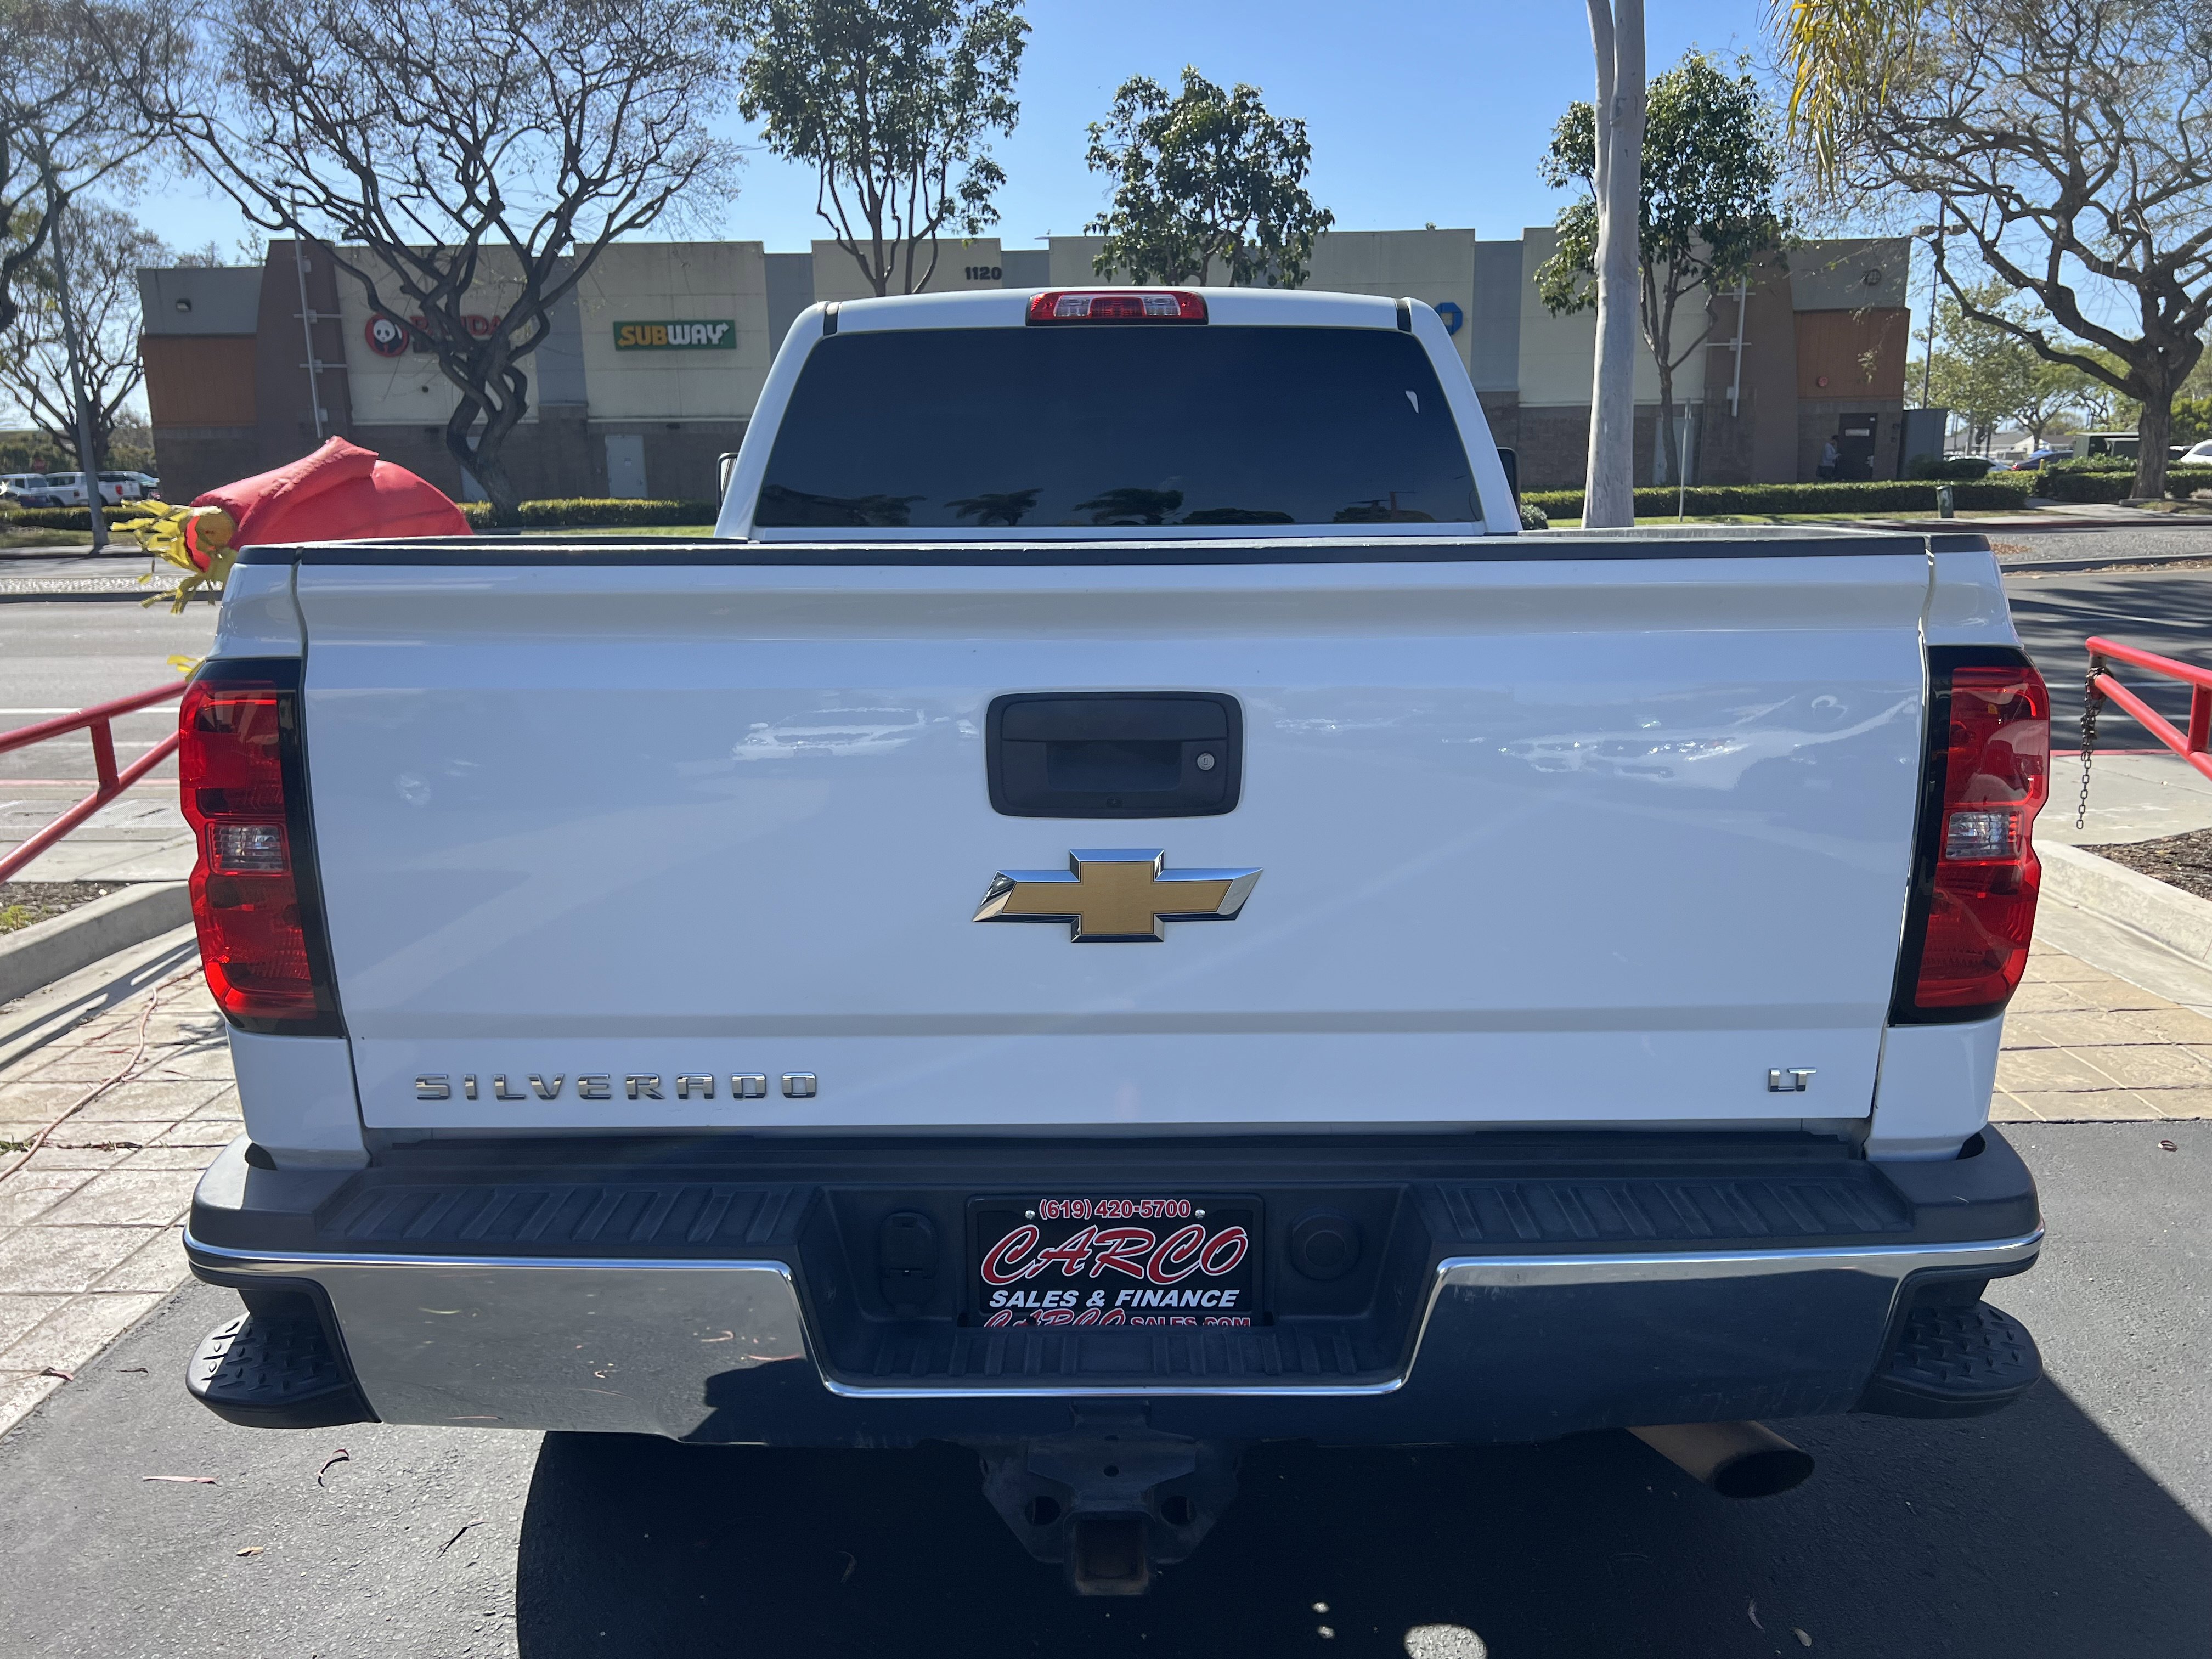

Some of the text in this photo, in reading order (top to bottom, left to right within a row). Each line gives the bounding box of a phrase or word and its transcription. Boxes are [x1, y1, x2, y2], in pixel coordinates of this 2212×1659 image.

[965, 267, 1002, 280] 1120
[618, 323, 729, 346] SUBWAY
[415, 1071, 817, 1101] SILVERADO
[1768, 1066, 1817, 1092] LT
[1039, 1199, 1191, 1220] (619) 420-5700
[981, 1224, 1248, 1285] CARCO
[989, 1289, 1240, 1308] SALES & FINANCE
